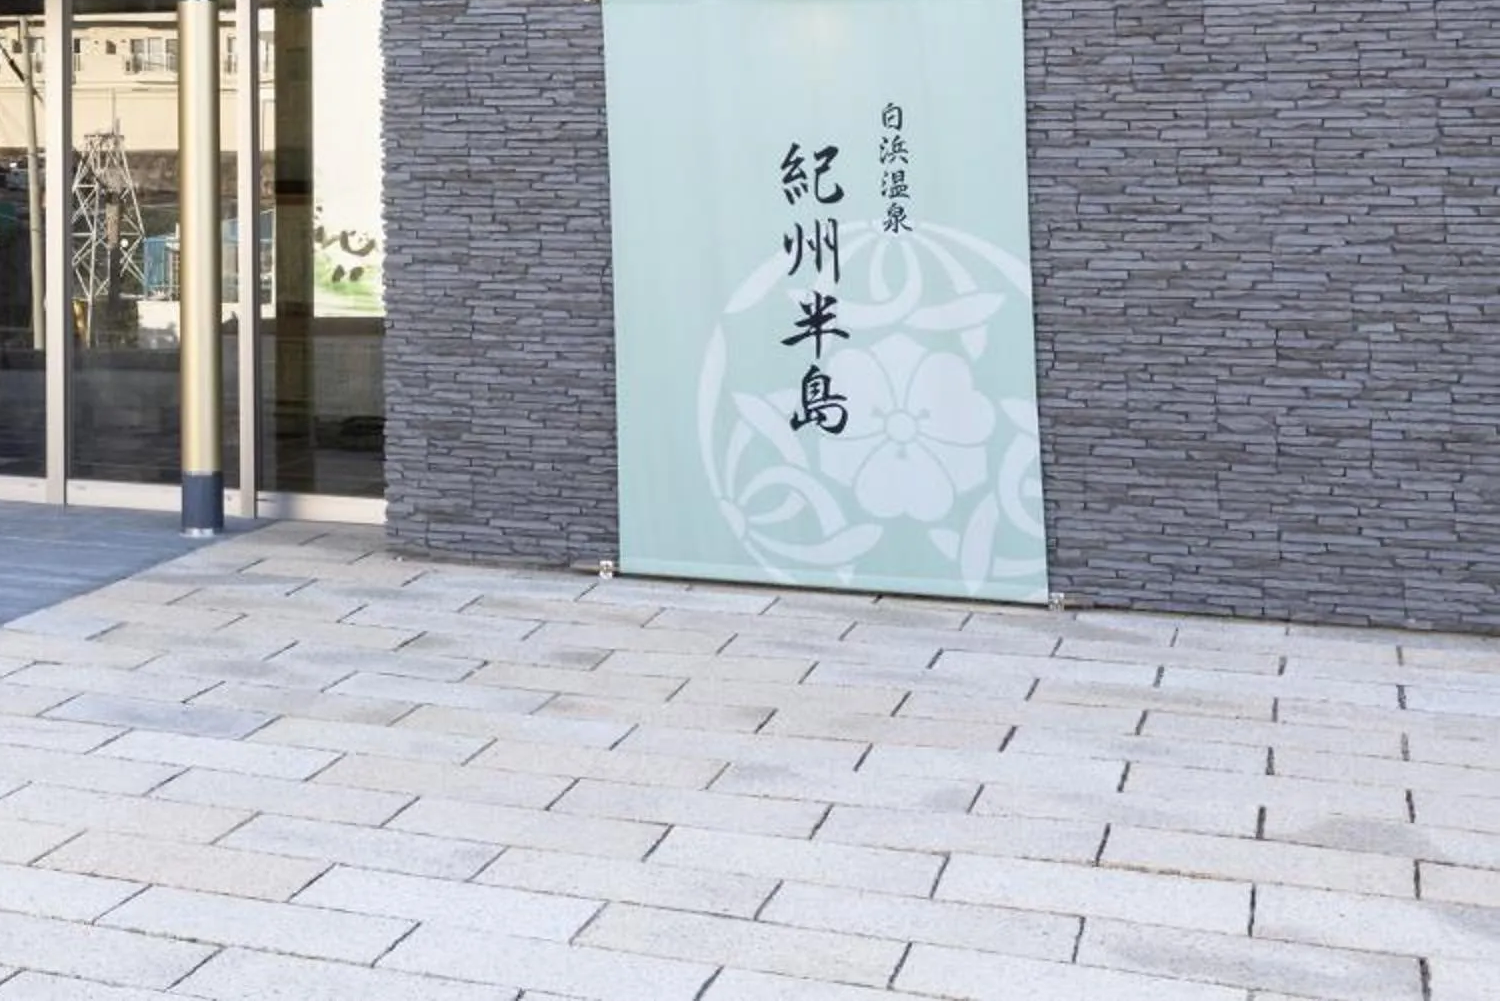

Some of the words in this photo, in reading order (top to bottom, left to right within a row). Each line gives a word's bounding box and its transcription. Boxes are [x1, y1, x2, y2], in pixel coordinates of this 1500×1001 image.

[879, 102, 913, 233] 白浜温泉
[779, 142, 850, 436] 紀州半島
